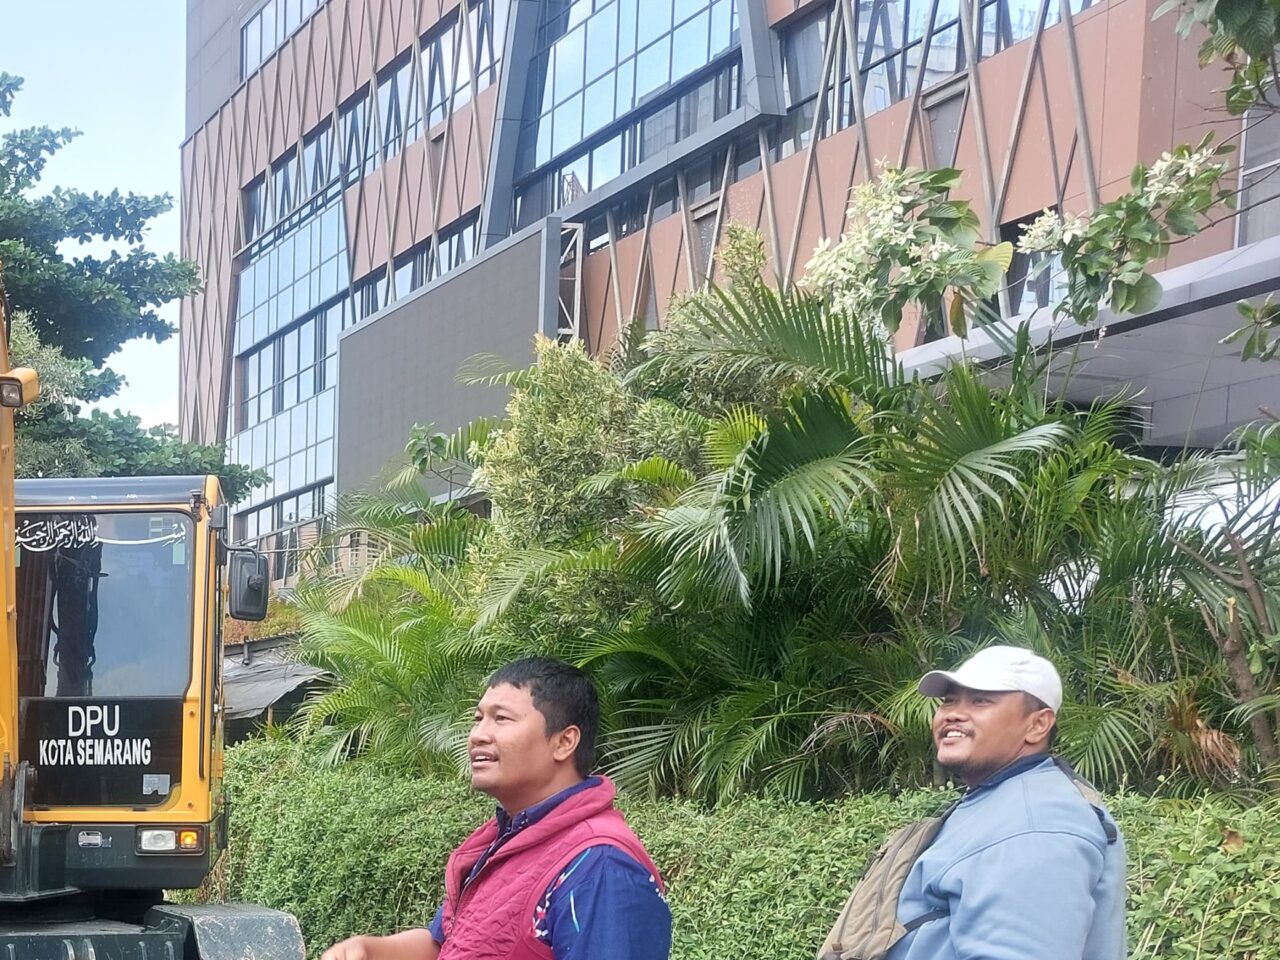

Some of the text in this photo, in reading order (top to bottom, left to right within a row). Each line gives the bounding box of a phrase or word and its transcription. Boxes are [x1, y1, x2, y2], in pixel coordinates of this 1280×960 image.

[68, 704, 120, 737] DPU
[39, 738, 152, 766] KOTA SEMARANG
